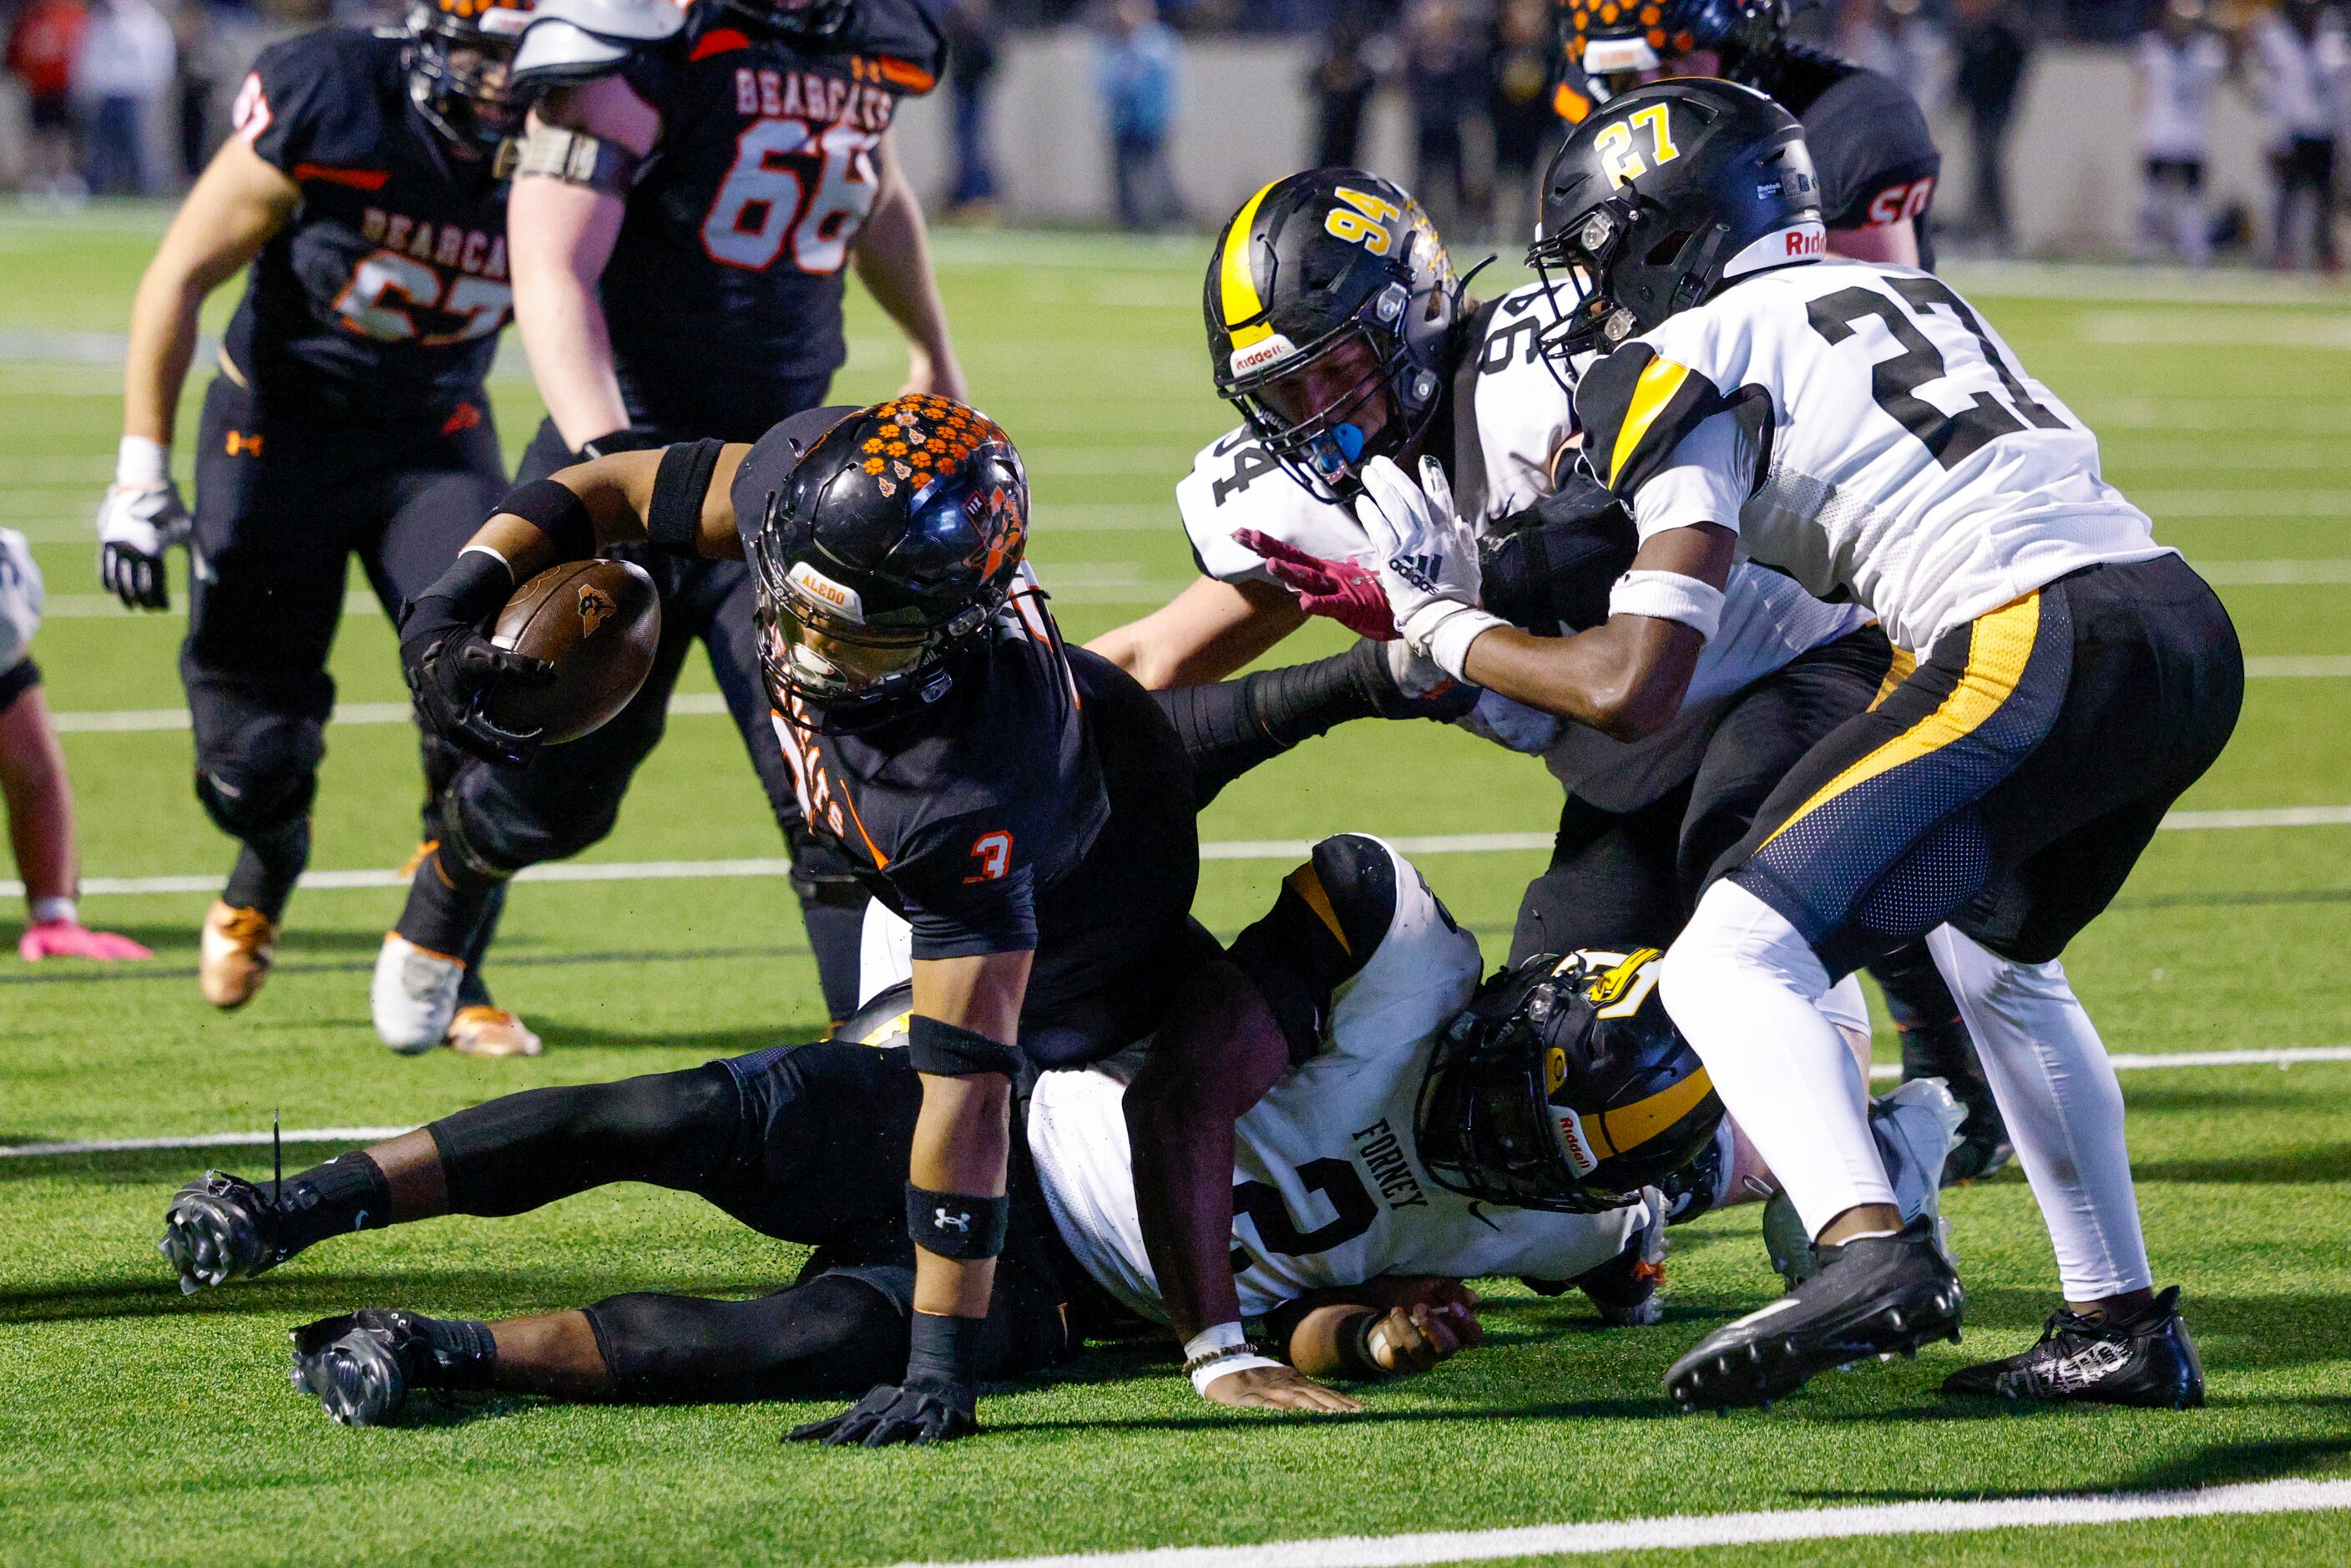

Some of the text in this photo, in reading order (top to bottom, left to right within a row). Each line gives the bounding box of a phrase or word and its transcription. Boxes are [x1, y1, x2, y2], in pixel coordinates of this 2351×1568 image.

[1593, 101, 1681, 192] 27
[1324, 185, 1401, 256] 94
[334, 247, 513, 345] 67
[1482, 281, 1573, 376] 94
[1236, 345, 1282, 370] Riddell
[1805, 276, 2071, 473] 27
[801, 574, 845, 606] ALEDO
[1389, 557, 1439, 596] adidas
[961, 829, 1014, 885] 3
[1352, 1117, 1428, 1211] FORNEY
[1560, 1116, 1590, 1169] Riddell
